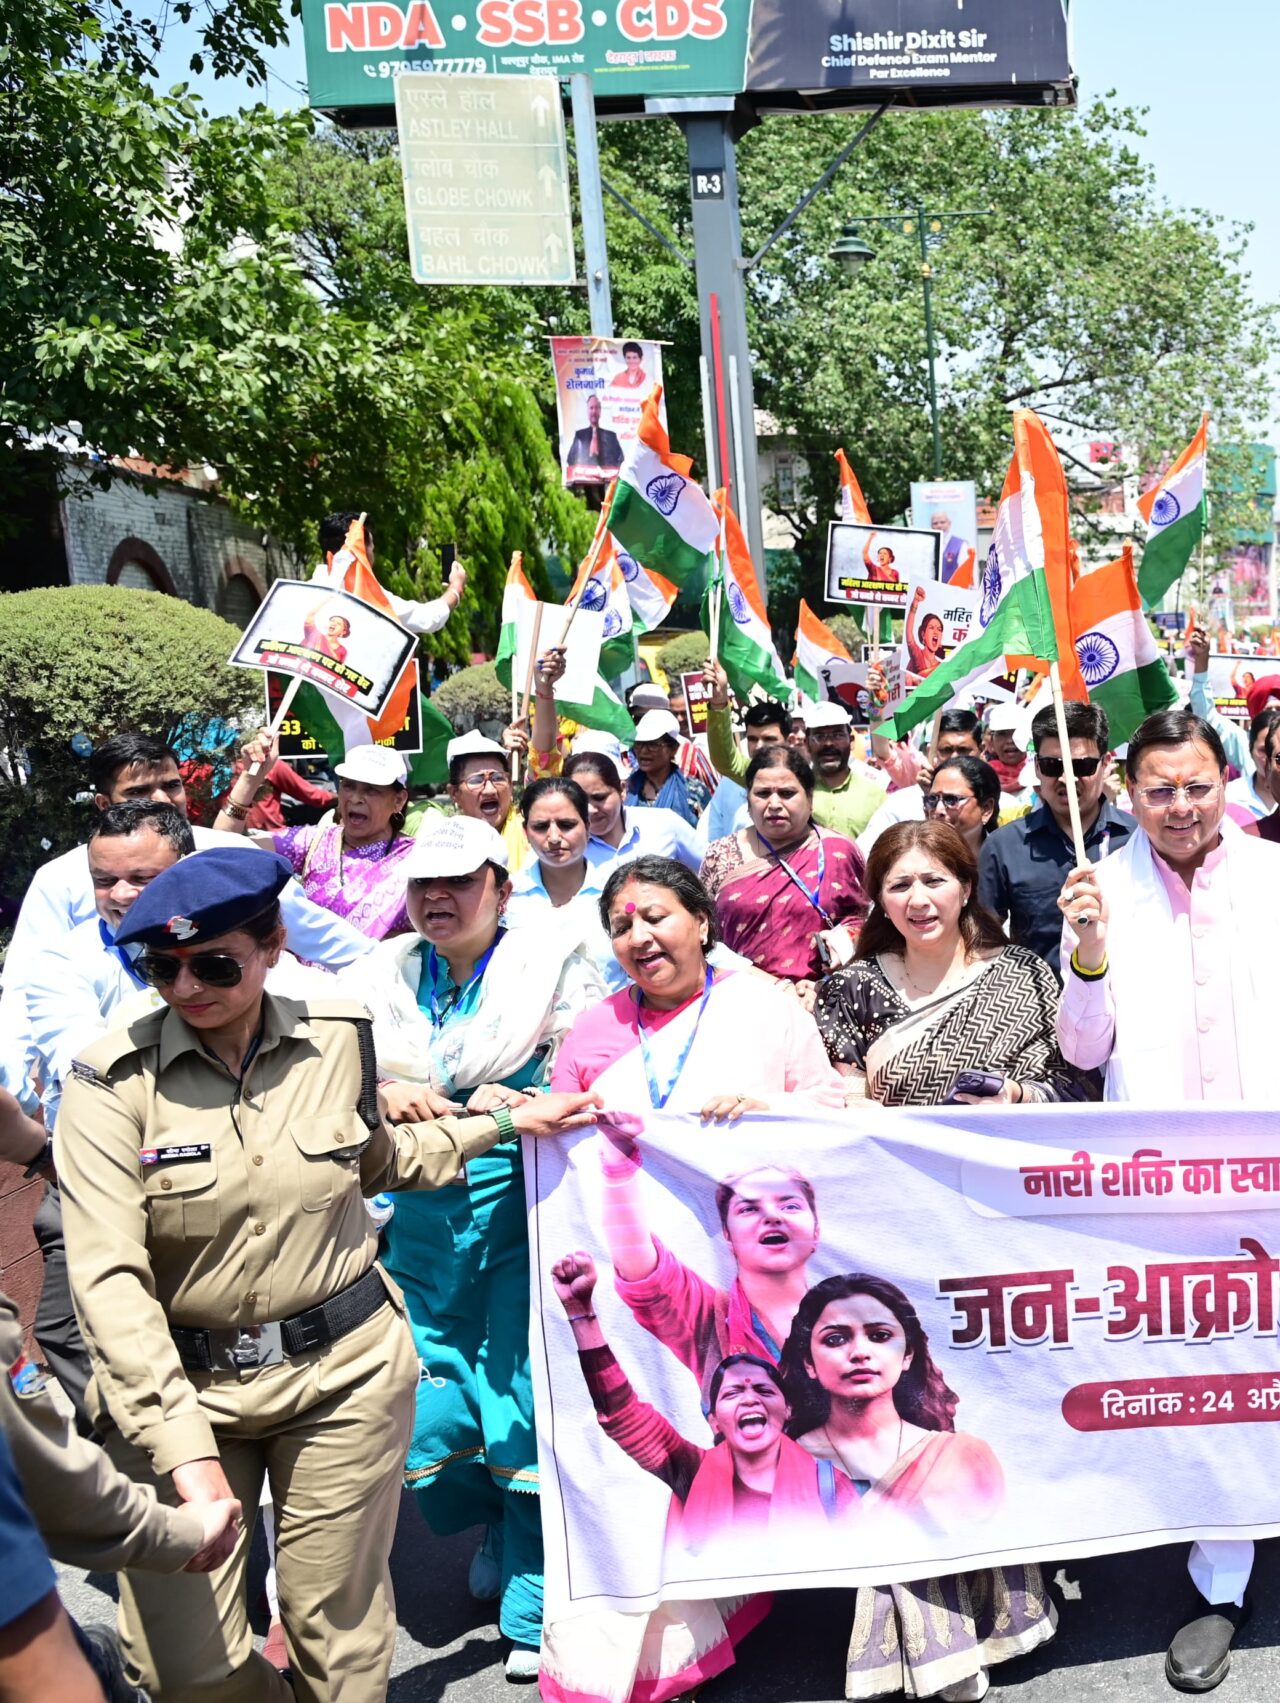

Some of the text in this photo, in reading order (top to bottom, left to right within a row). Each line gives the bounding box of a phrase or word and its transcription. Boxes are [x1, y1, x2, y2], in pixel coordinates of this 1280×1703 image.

[325, 0, 728, 52] NDA SSB CDS
[830, 28, 988, 53] Shishir Dixit Sir
[822, 51, 998, 68] Chief Defence Exam Mentor
[869, 66, 950, 79] Par Excellence
[409, 120, 519, 139] ASTLEY HALL
[697, 175, 721, 194] R-3
[415, 186, 534, 208] GLOBE CHOWK
[419, 226, 461, 249] बहल
[422, 255, 549, 276] BAHL CHOWK
[280, 719, 310, 736] 33
[1020, 1151, 1095, 1198] नारी
[1101, 1149, 1176, 1197] शक्ति
[1179, 1158, 1224, 1195] का
[1101, 1387, 1184, 1419] दिनांक
[1202, 1390, 1235, 1414] 24
